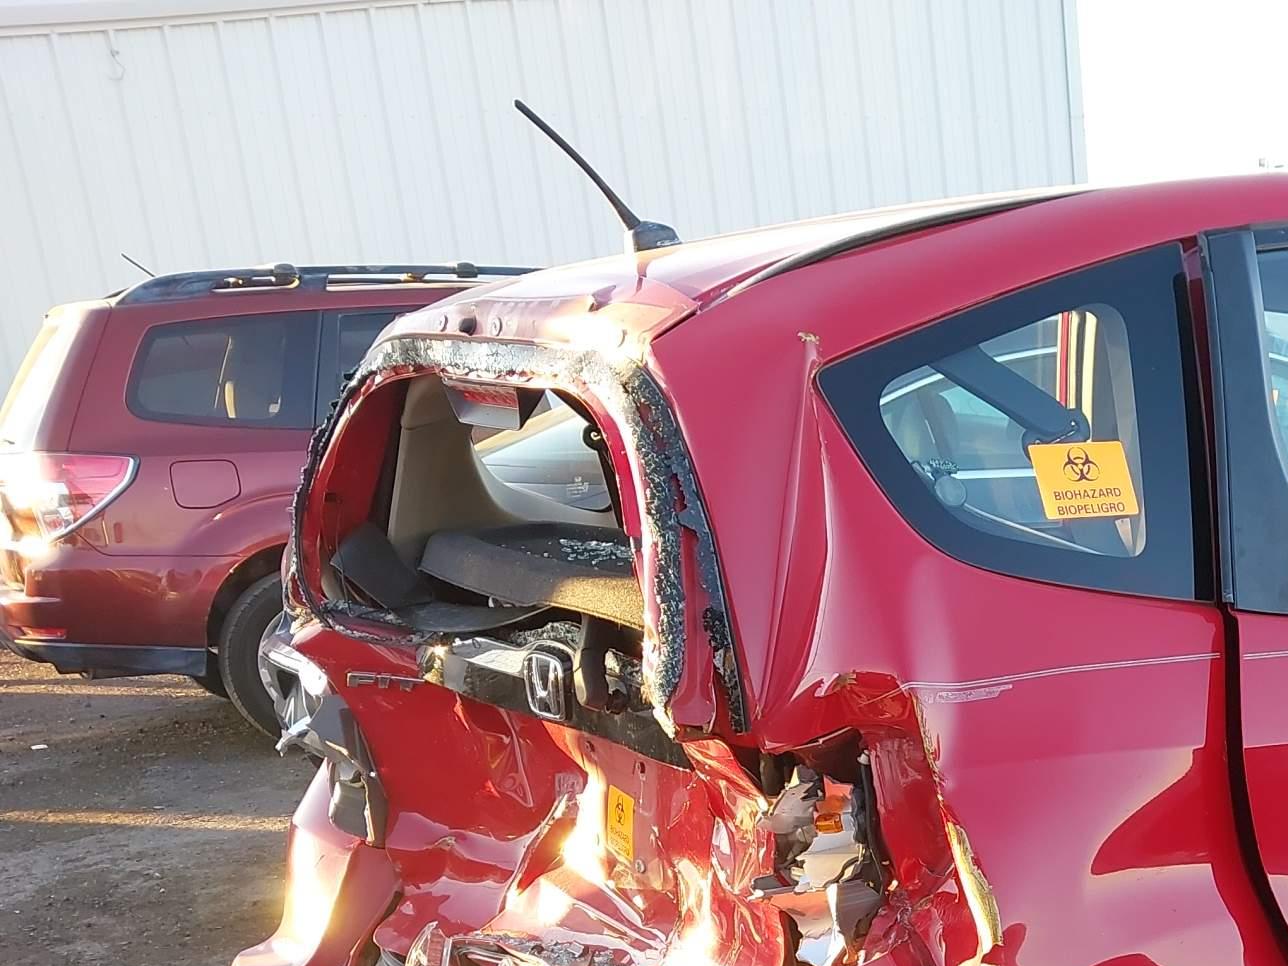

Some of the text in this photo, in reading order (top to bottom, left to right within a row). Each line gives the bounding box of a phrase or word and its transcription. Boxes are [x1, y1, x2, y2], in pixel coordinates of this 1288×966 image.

[1053, 487, 1121, 501] BIOHAZARD
[1057, 502, 1126, 516] BIOPELIGRO
[346, 672, 425, 692] FIT
